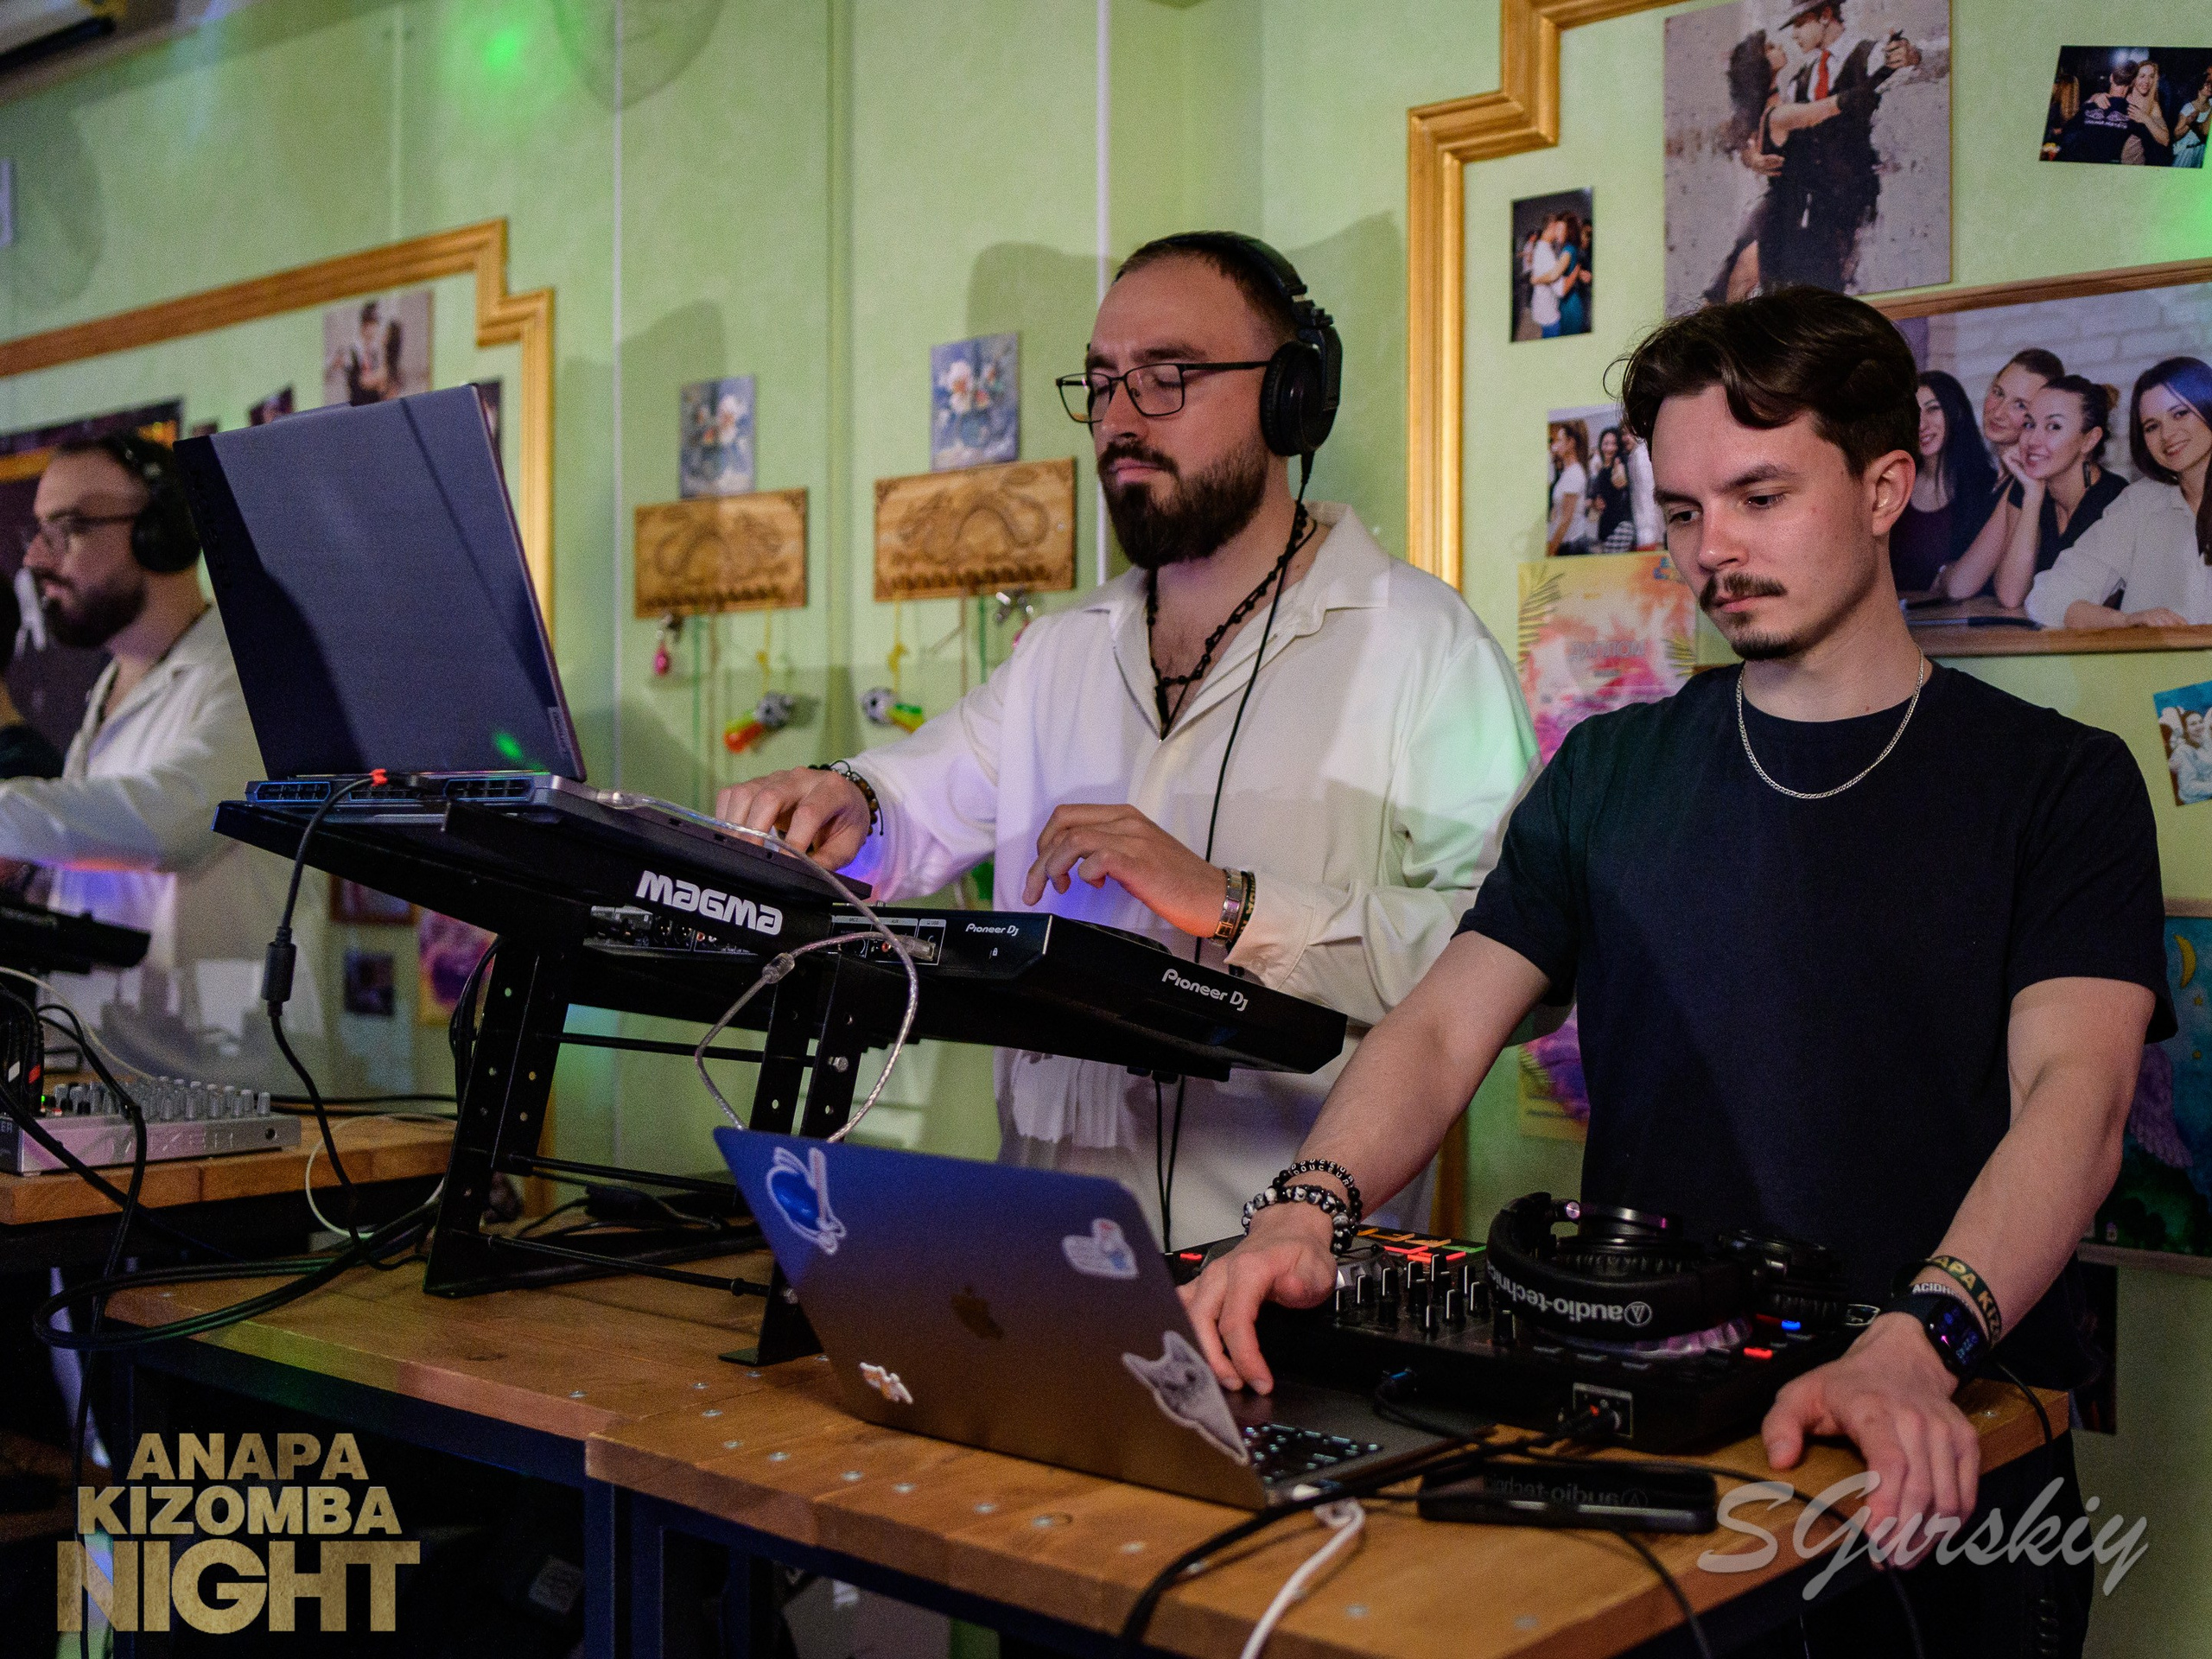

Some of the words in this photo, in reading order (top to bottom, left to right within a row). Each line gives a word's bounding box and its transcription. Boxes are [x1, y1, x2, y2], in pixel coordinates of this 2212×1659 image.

[965, 923, 1006, 934] Pioneer
[1161, 969, 1228, 1001] Pioneer
[1229, 990, 1249, 1012] DJ
[1933, 1256, 1977, 1290] APA
